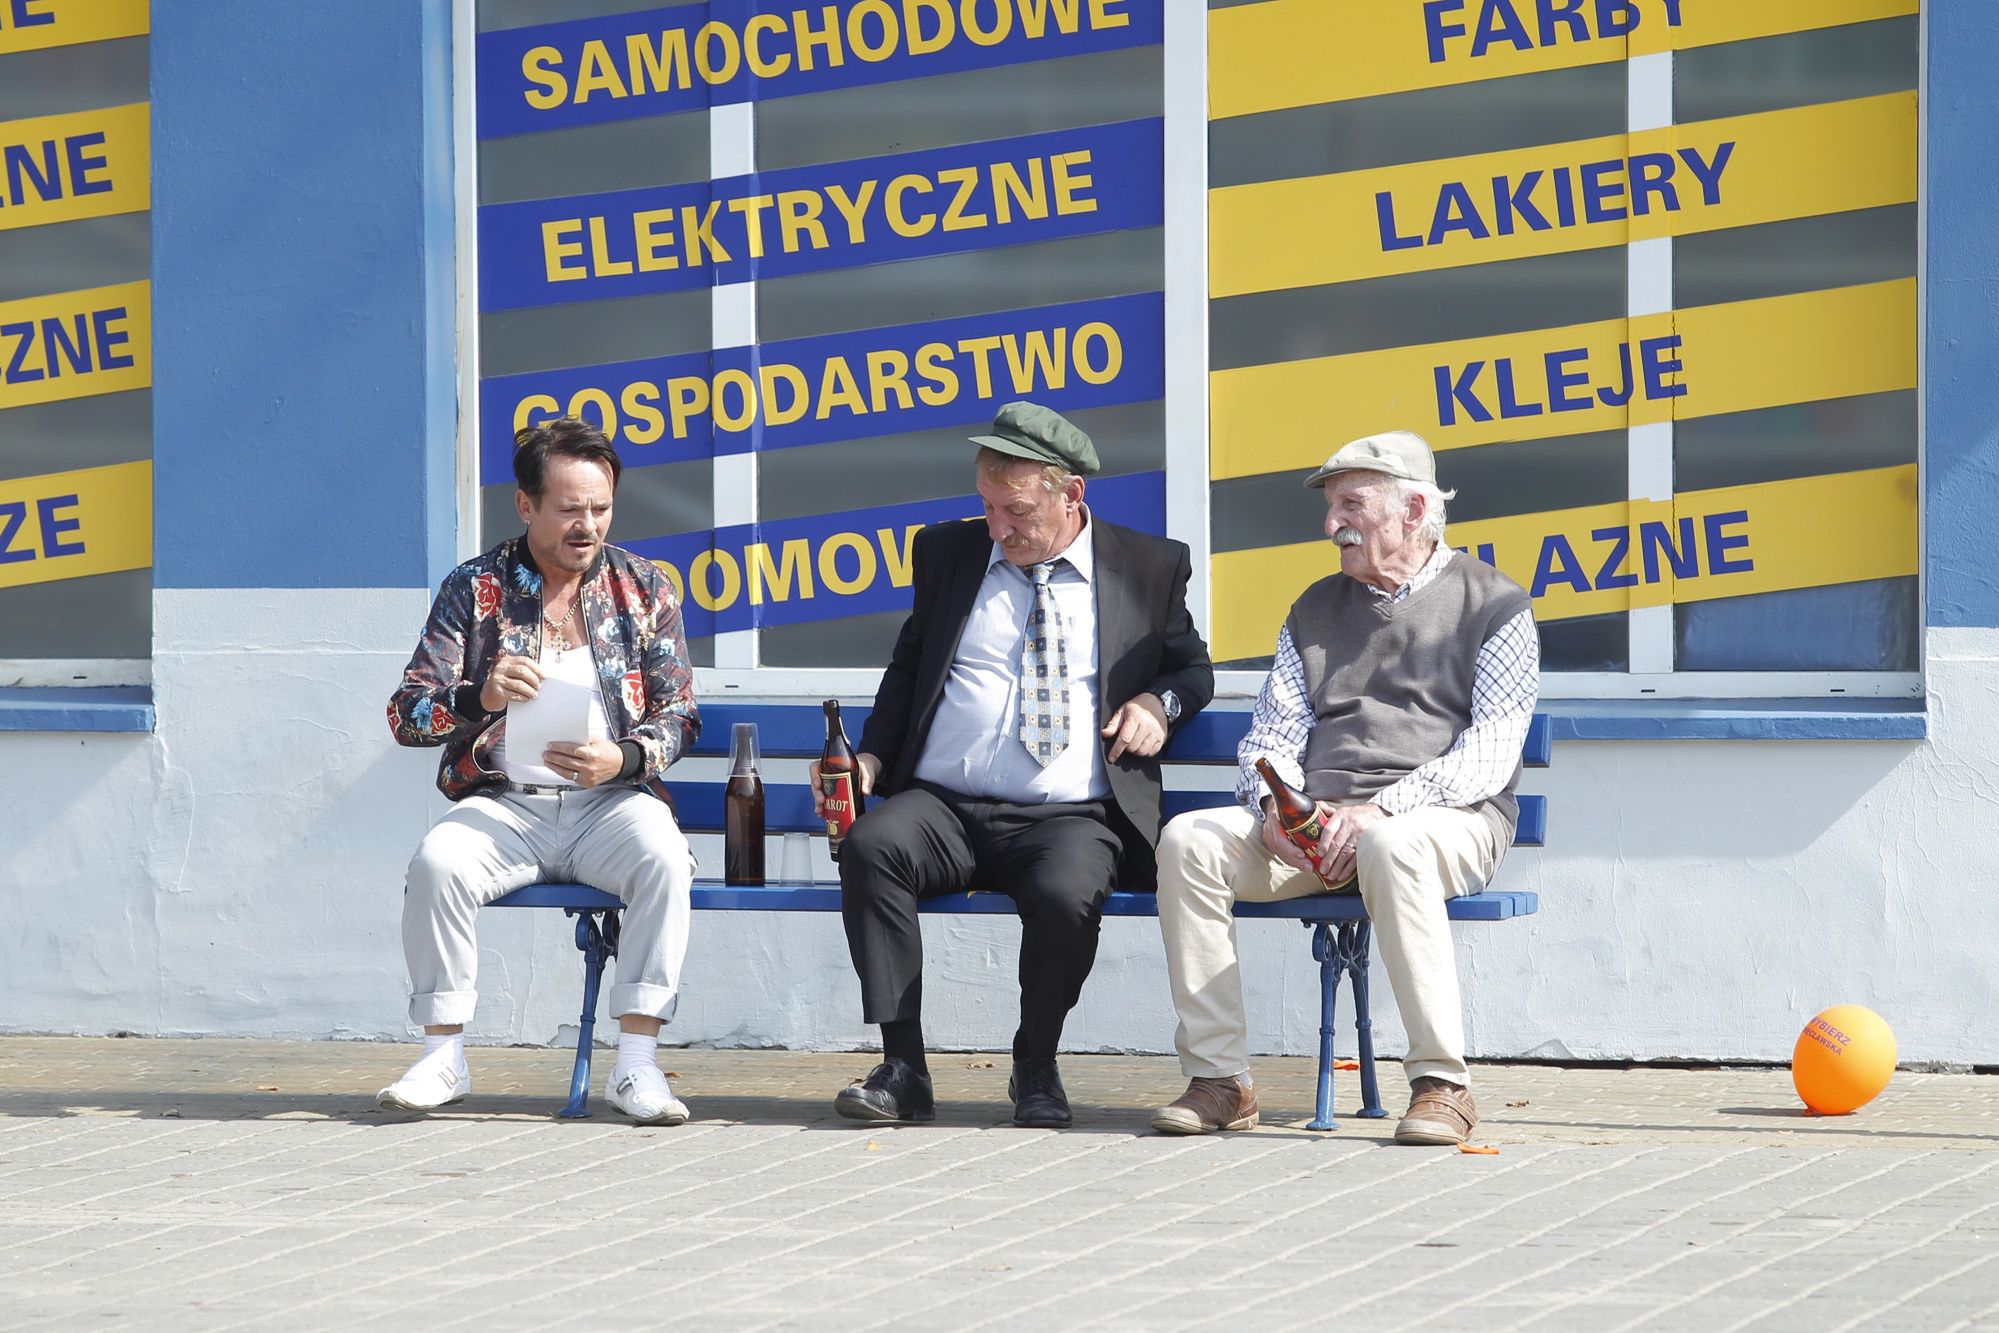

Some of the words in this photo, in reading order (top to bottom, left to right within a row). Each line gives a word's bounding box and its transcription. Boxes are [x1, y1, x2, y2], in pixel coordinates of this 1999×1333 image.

[0, 132, 113, 208] NE
[542, 150, 1098, 282] ELEKTRYCZNE
[1375, 142, 1736, 251] LAKIERY
[0, 307, 134, 384] ZNE
[513, 321, 1123, 445] GOSPODARSTWO
[1434, 335, 1688, 426] KLEJE
[651, 516, 986, 612] OMOW
[1452, 510, 1754, 598] AZNE
